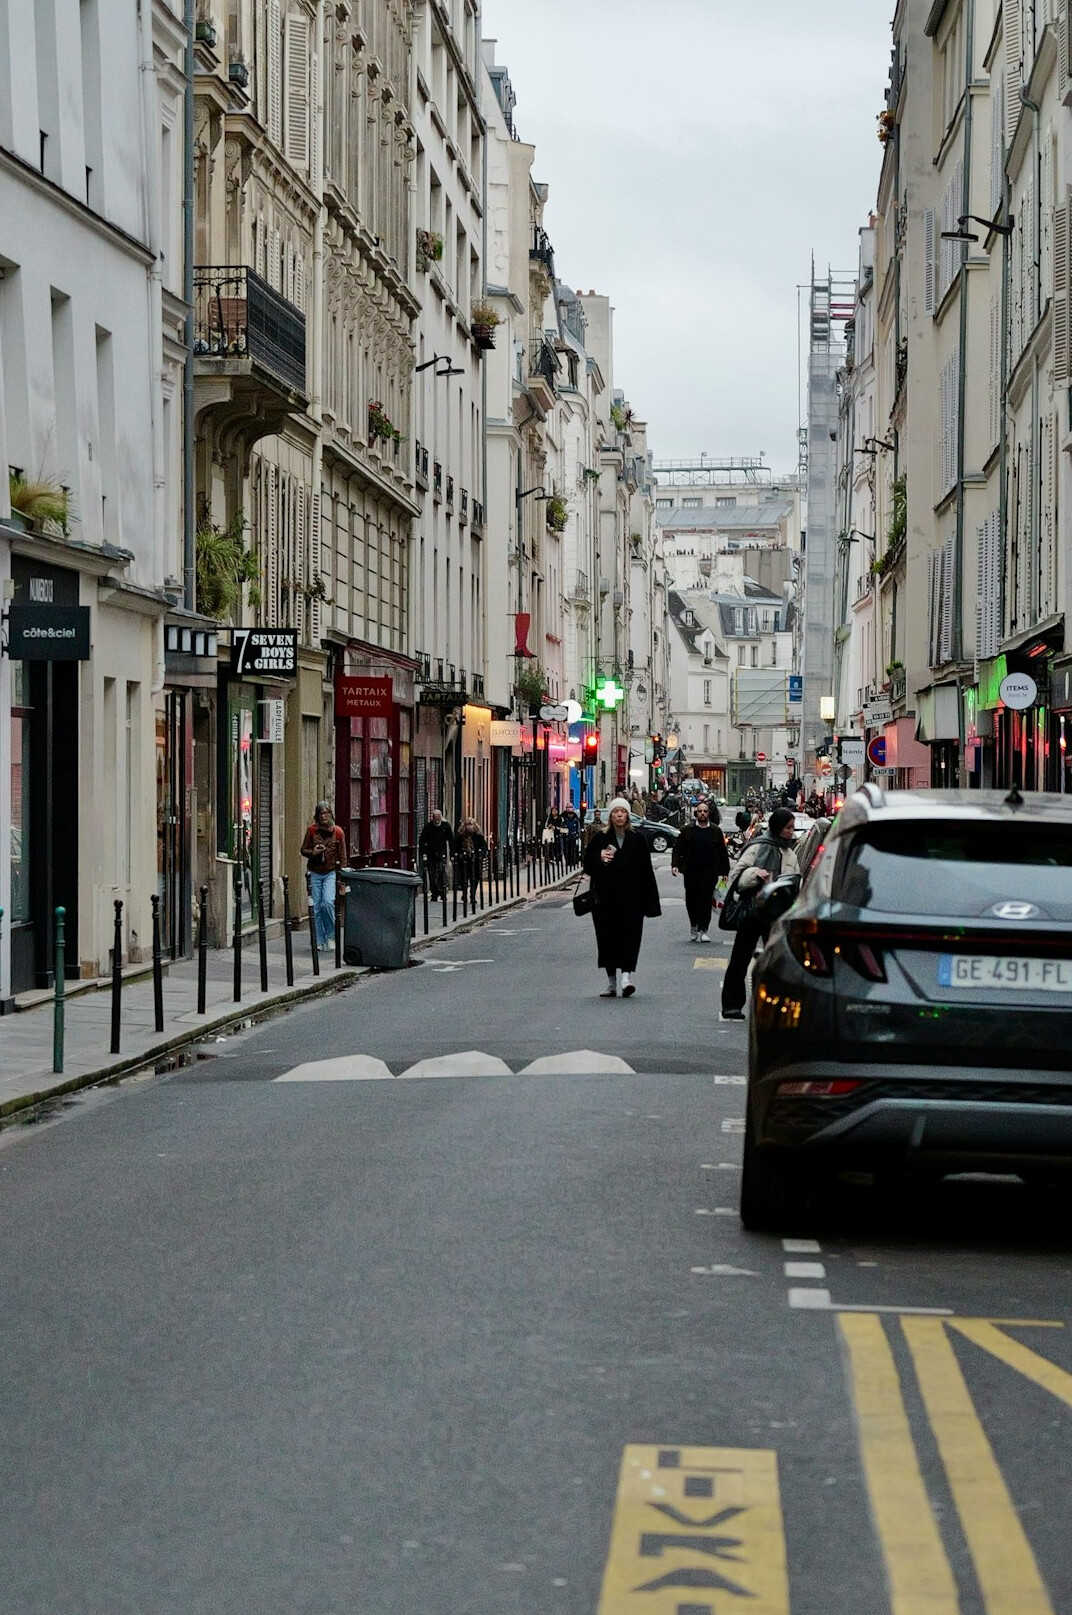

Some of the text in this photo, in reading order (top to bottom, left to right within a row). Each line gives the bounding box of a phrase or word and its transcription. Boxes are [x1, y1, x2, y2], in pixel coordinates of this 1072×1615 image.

[251, 634, 294, 646] SEVEN
[233, 629, 250, 673] 7
[261, 646, 294, 658] BOYS
[244, 658, 294, 670] & GIRLS
[342, 687, 387, 697] TARTAIX
[1006, 684, 1029, 692] ITEMS
[420, 692, 465, 702] TARTAIX
[346, 699, 382, 707] METAUX
